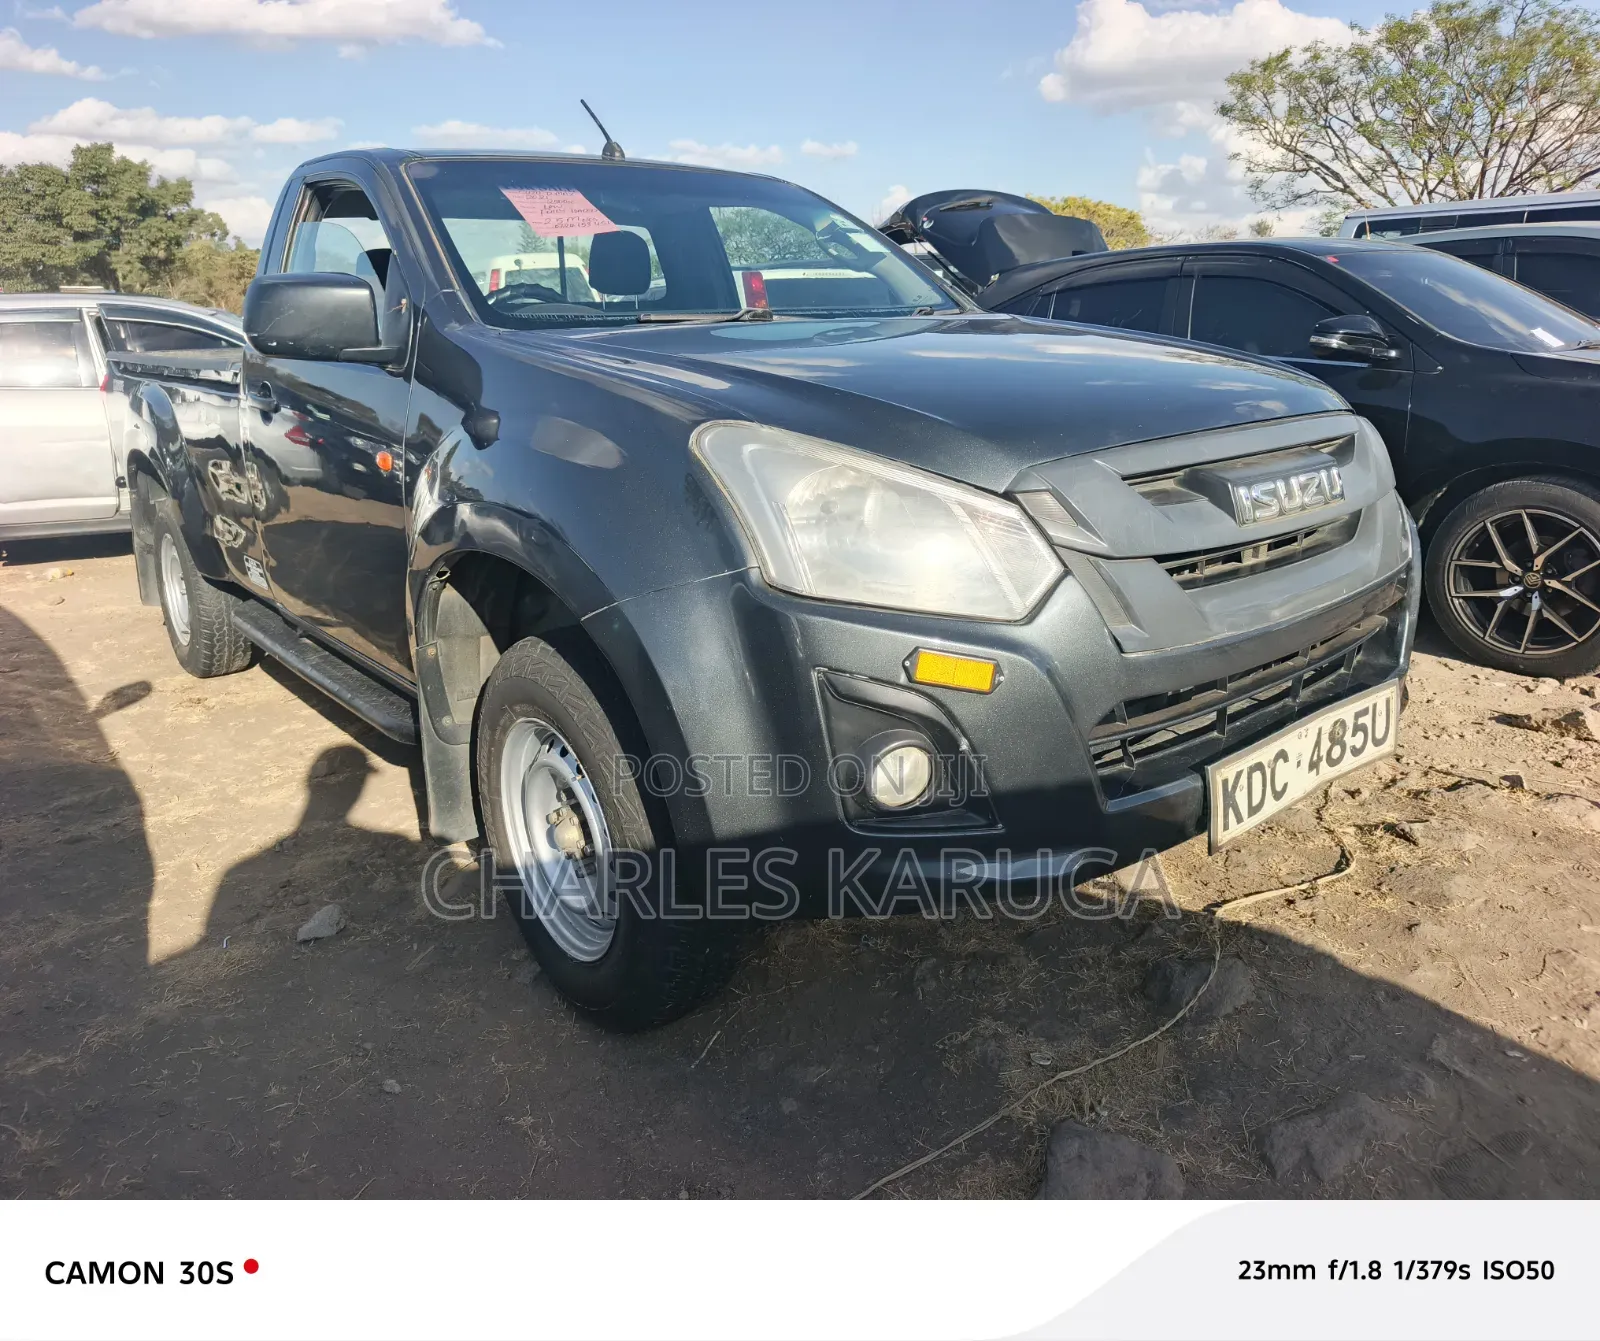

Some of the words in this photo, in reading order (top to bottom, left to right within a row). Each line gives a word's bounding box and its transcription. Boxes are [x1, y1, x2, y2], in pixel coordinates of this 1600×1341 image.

[1235, 466, 1344, 523] ISUZU
[1221, 748, 1290, 833] KDC
[1308, 697, 1391, 776] 485U
